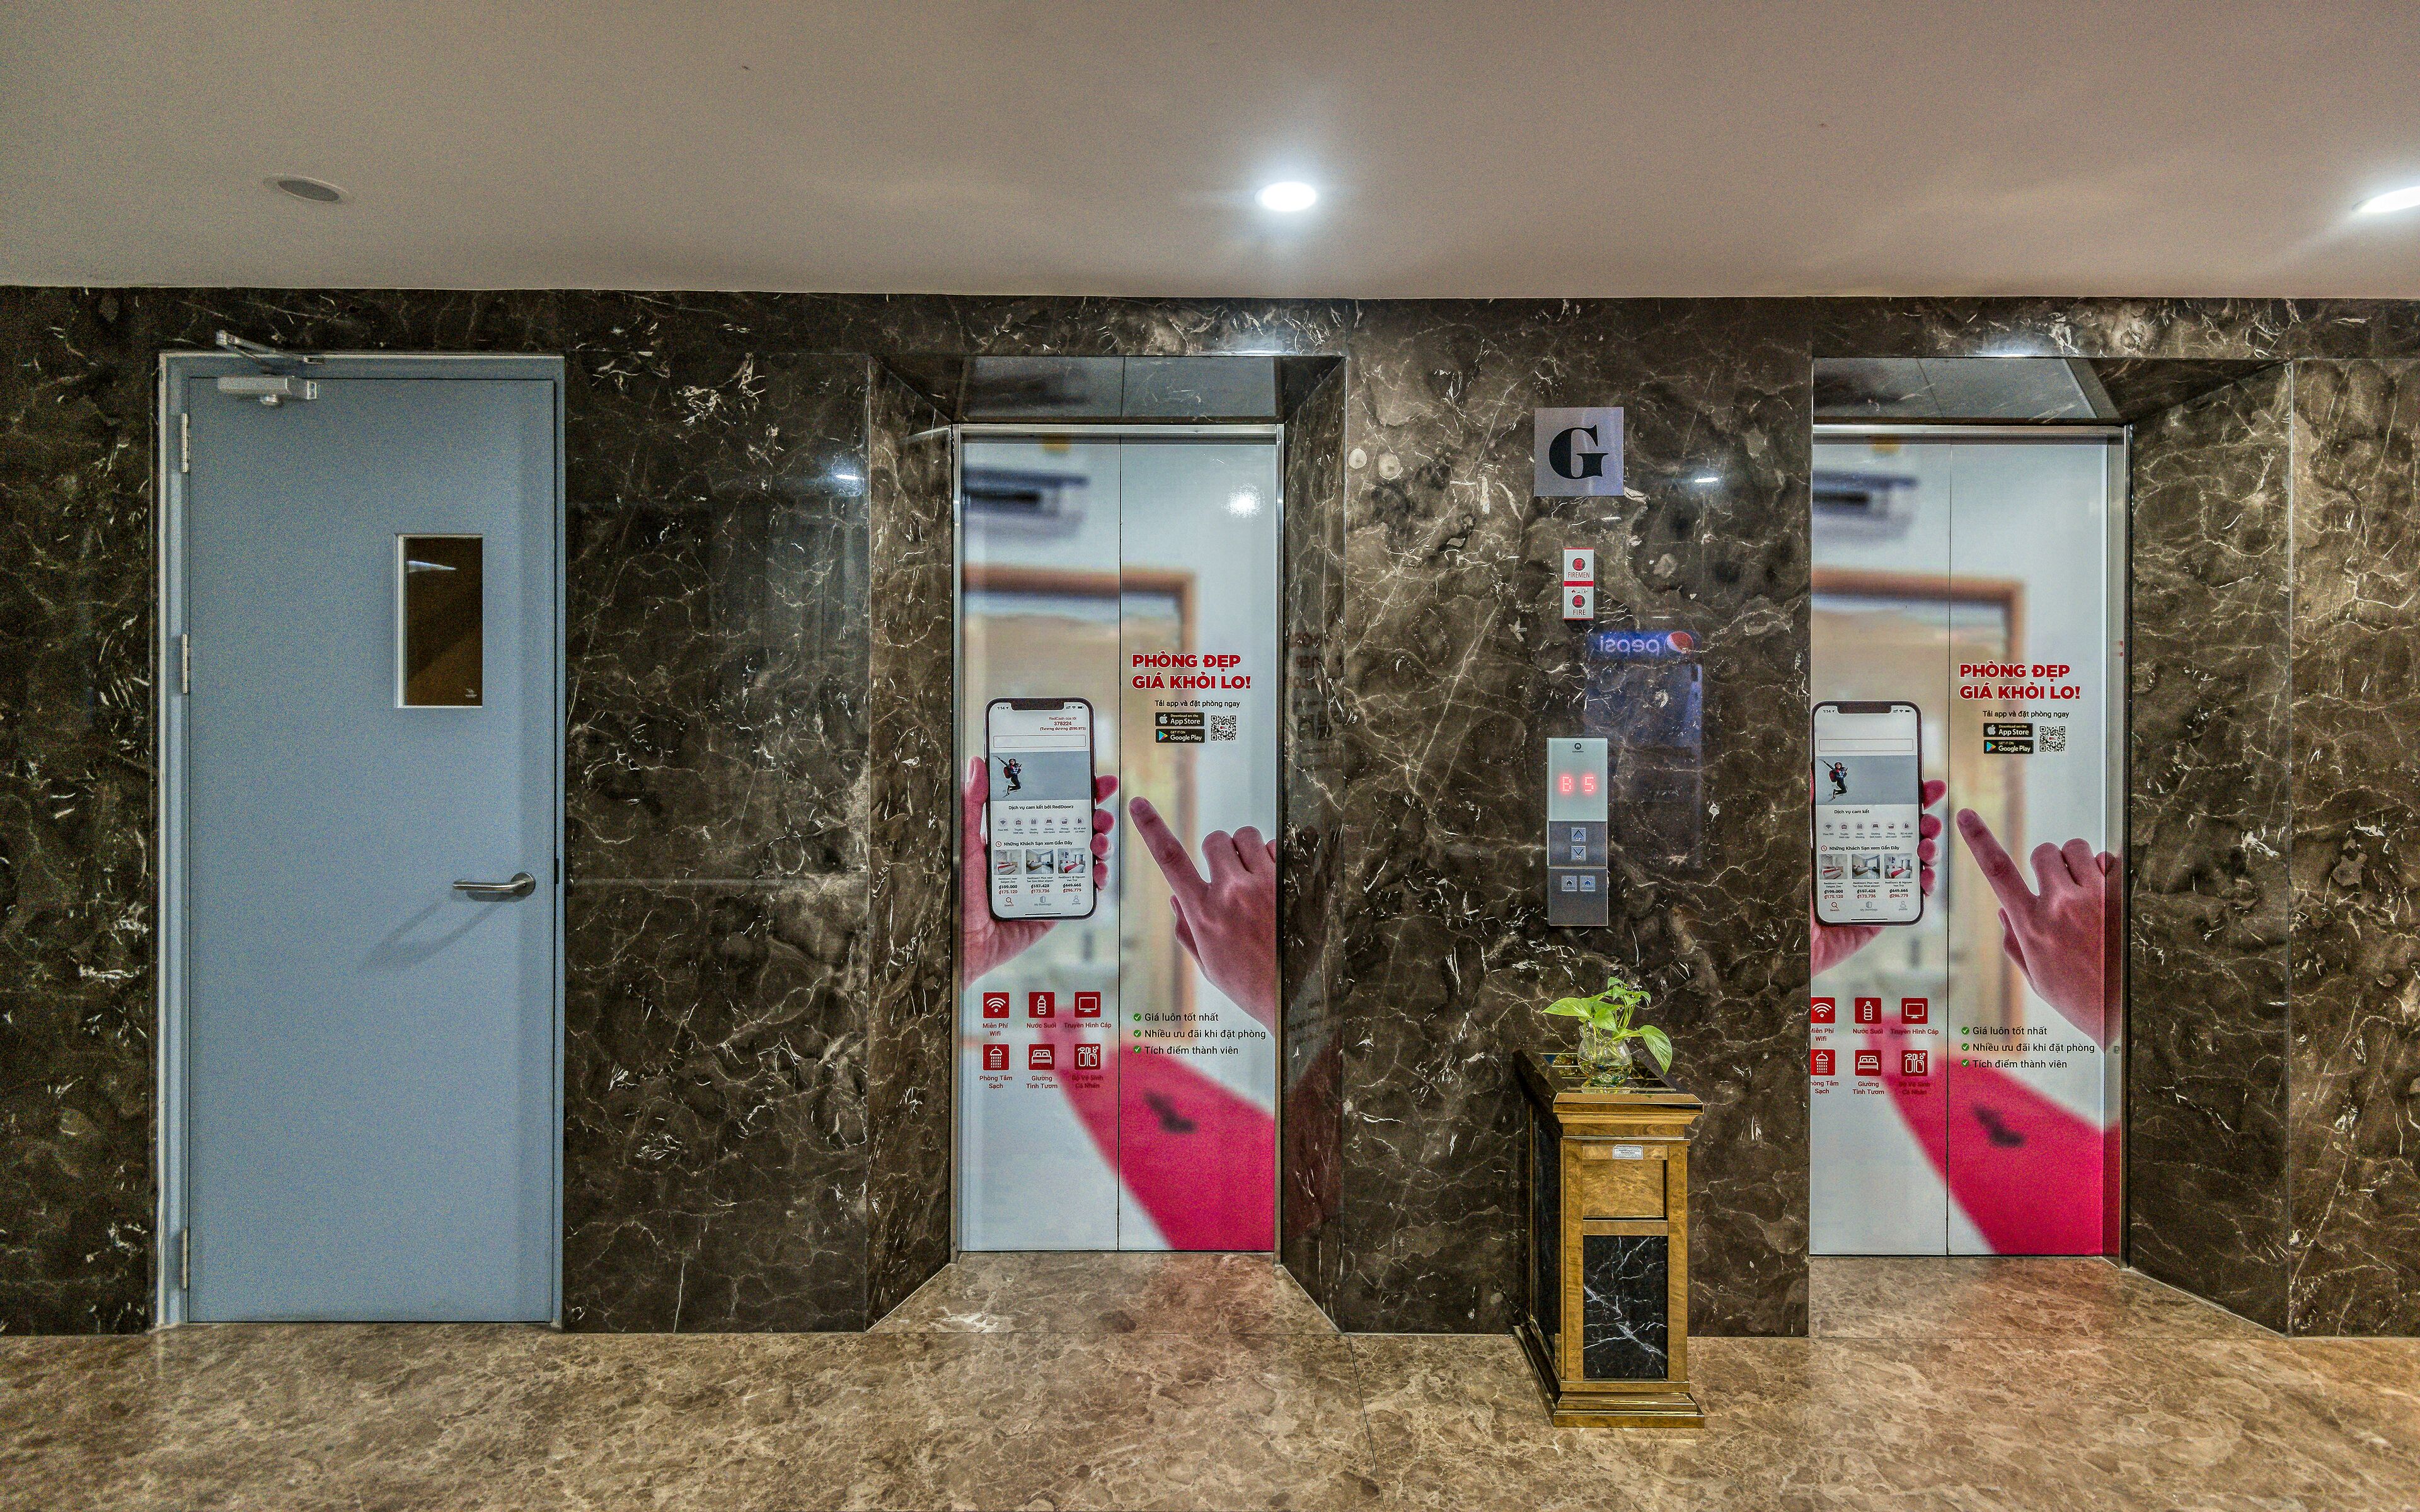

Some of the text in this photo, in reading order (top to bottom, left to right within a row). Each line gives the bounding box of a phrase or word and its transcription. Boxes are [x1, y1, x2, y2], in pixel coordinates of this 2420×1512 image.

[1549, 424, 1609, 479] G
[1132, 651, 1241, 672] PHÒNG ĐẸP
[1960, 661, 2070, 682] PHÒNG ĐẸP
[1132, 671, 1252, 689] GIÁ KHỎI LO!
[1959, 682, 2081, 699] GIÁ KHỎI LO!
[1202, 700, 1223, 708] phòng
[1144, 1012, 1219, 1021] Giá luôn tốt nhất
[1144, 1029, 1171, 1038] Nhiều
[1187, 1029, 1202, 1038] đãi
[1204, 1029, 1218, 1038] khi
[1220, 1029, 1235, 1040] đặt
[1238, 1029, 1266, 1040] phòng
[1973, 1026, 2047, 1035] Giá luôn tốt nhất
[1144, 1045, 1239, 1055] Tích điểm thành viên
[1973, 1042, 1999, 1051] Nhiều
[2016, 1043, 2031, 1051] đãi
[2033, 1043, 2046, 1051] khi
[2049, 1043, 2064, 1053] đặt
[2066, 1043, 2095, 1053] phòng
[1973, 1059, 2067, 1068] Tích điểm thành viên
